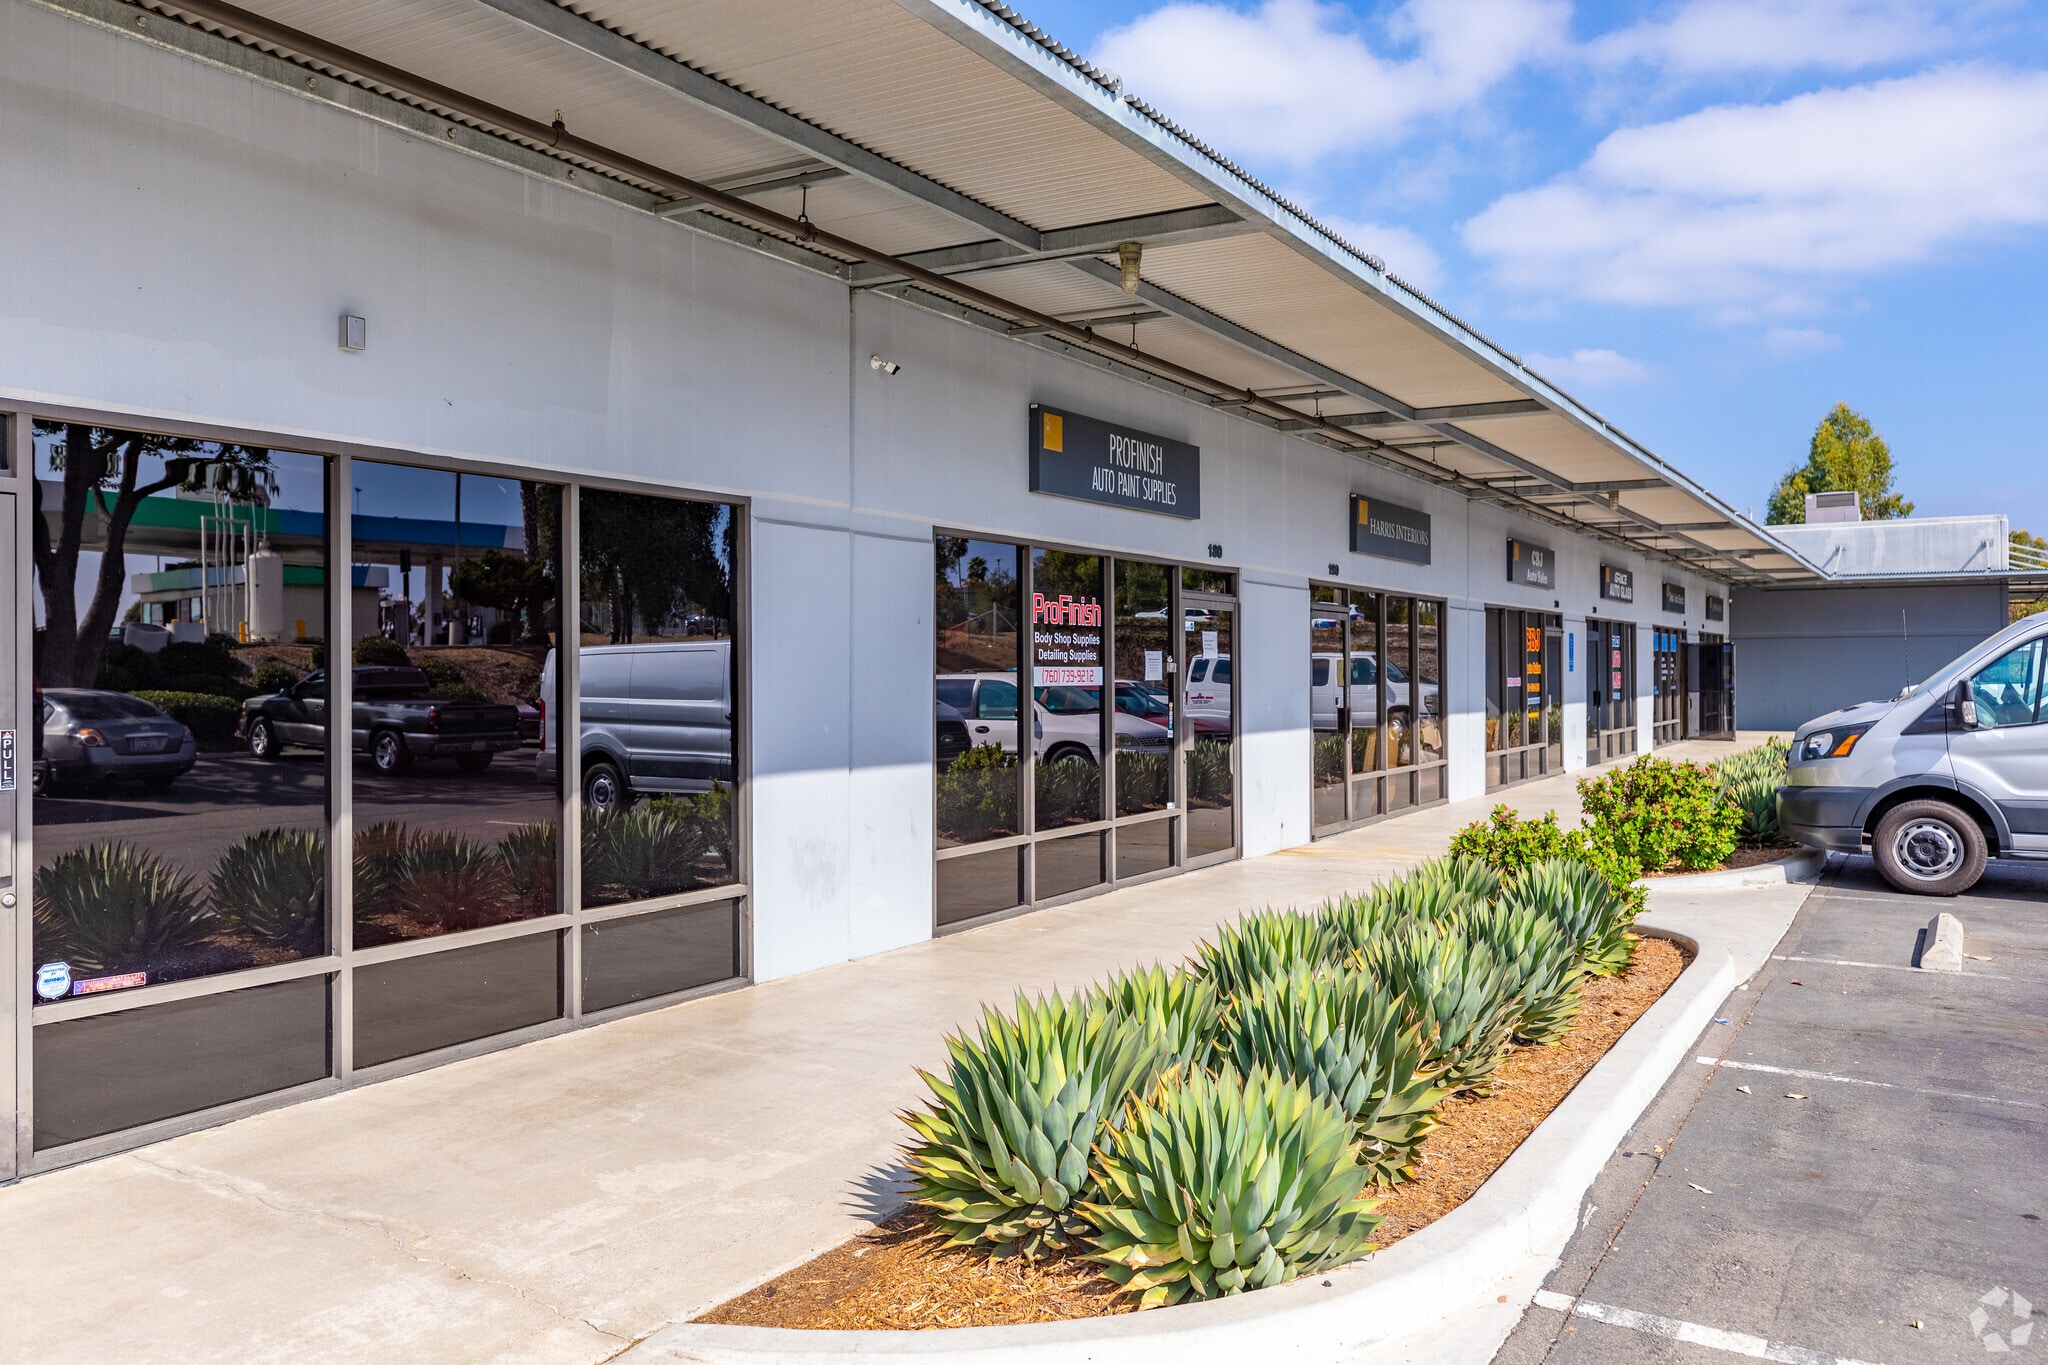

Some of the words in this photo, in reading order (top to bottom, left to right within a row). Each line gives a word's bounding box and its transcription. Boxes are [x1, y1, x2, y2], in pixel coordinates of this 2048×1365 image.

[1109, 433, 1163, 476] PROFINISH
[1092, 466, 1115, 494] AUTO
[1117, 471, 1140, 499] PAINT
[1142, 477, 1176, 506] SUPPLIES
[1369, 518, 1396, 540] HARRIS
[1395, 524, 1429, 546] INTERIORS
[1531, 550, 1544, 568] CBJ
[1526, 568, 1537, 583] Auto
[1033, 592, 1102, 627] ProFinish
[1034, 632, 1053, 646] Body
[1054, 632, 1072, 647] Shop
[1072, 633, 1100, 647] Supplies
[1038, 648, 1068, 663] Detailing
[1069, 649, 1097, 663] Supplies
[3, 739, 13, 780] PULL
